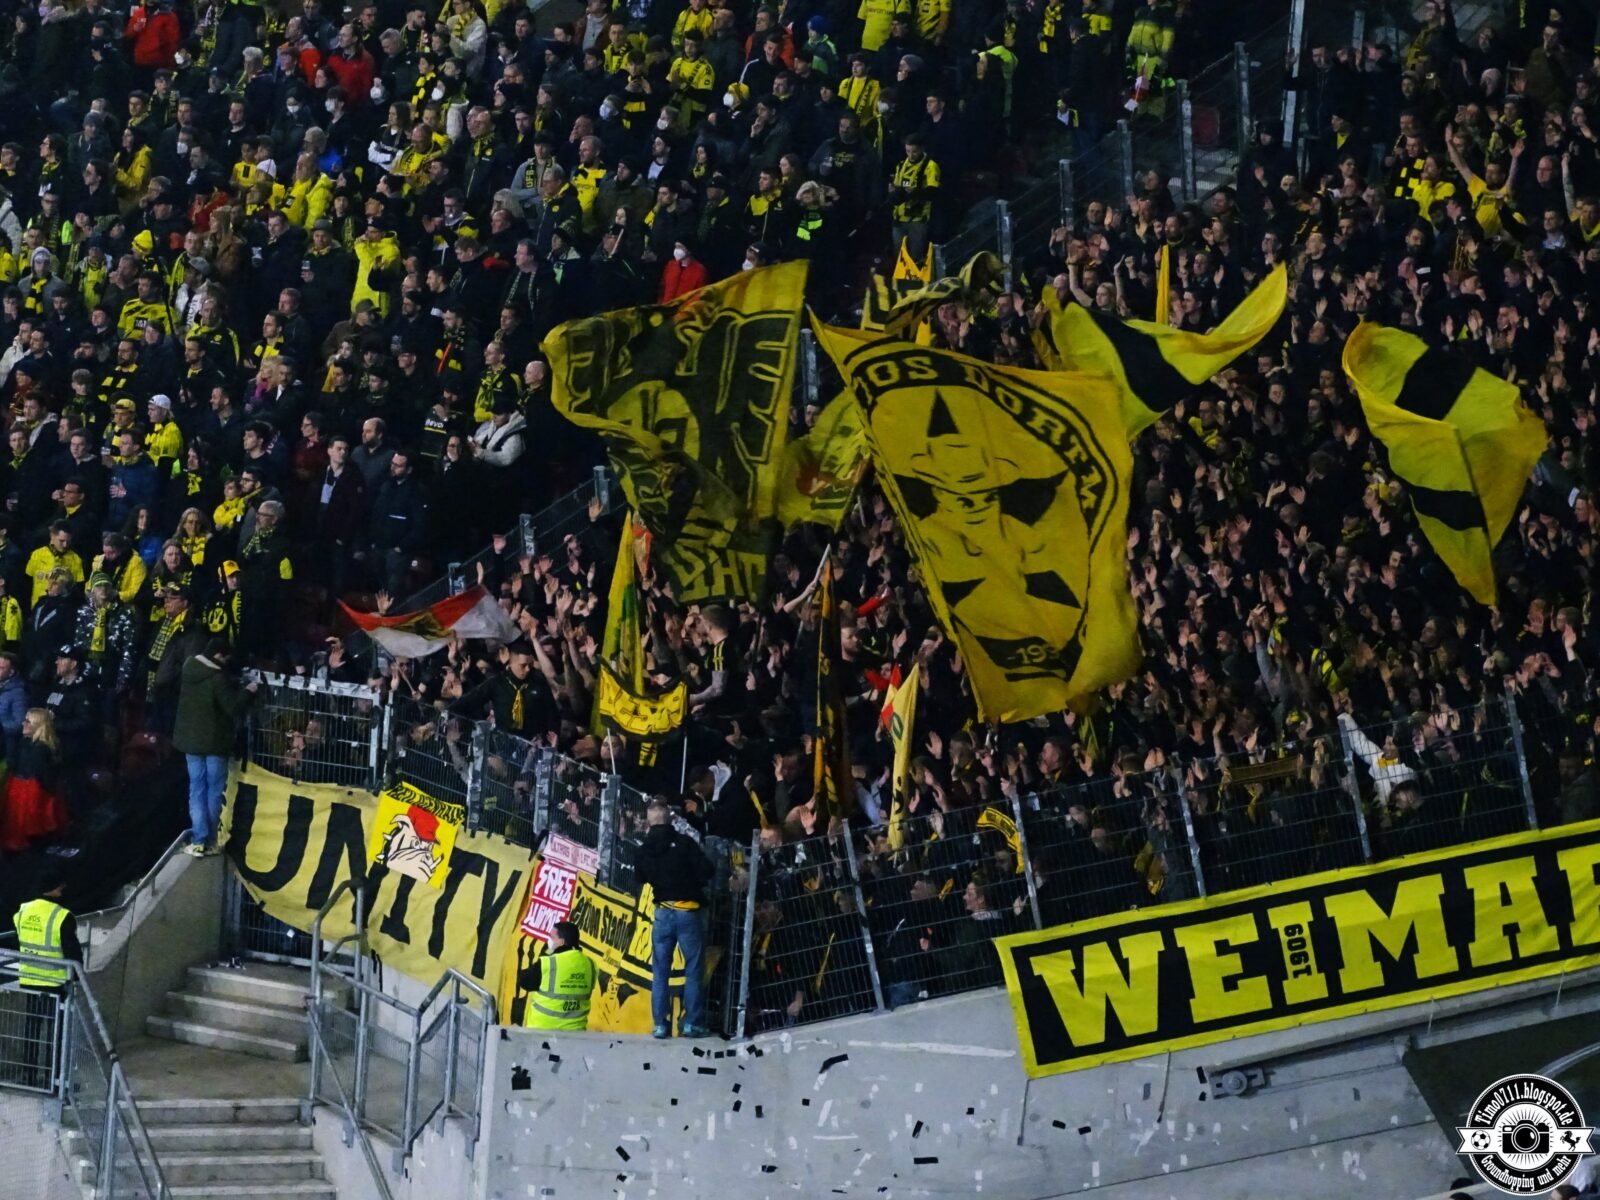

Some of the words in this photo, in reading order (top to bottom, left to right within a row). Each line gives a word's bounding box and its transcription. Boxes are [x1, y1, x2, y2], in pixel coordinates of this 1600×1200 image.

[227, 781, 522, 979] UNITY
[534, 863, 577, 907] FREE
[1284, 923, 1313, 979] 1909
